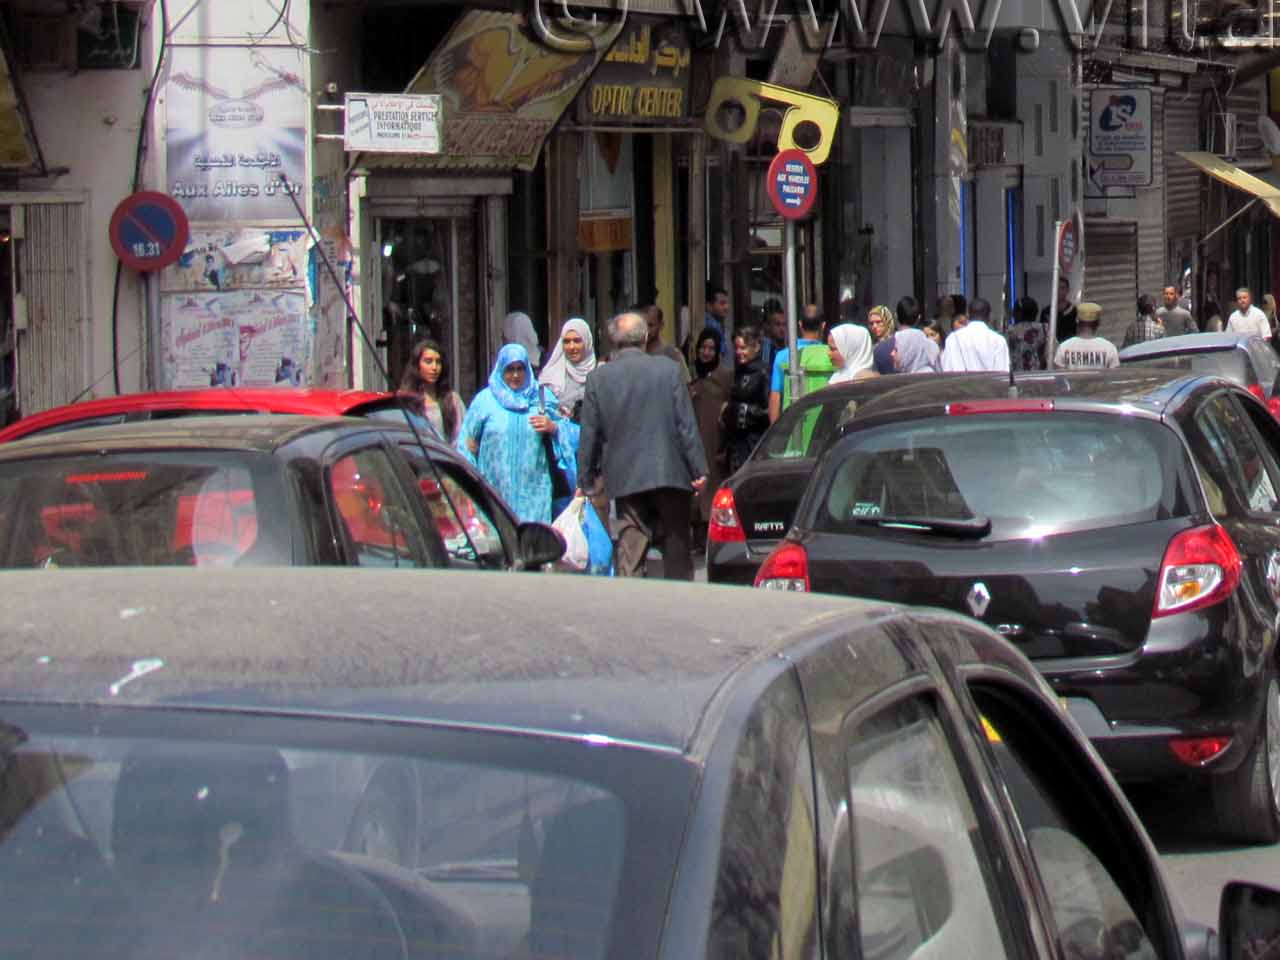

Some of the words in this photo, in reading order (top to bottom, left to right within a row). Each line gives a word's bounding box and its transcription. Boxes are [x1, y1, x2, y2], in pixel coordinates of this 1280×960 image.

[592, 85, 631, 115] OPTIC
[639, 86, 683, 117] CENTER
[172, 182, 209, 198] Aux
